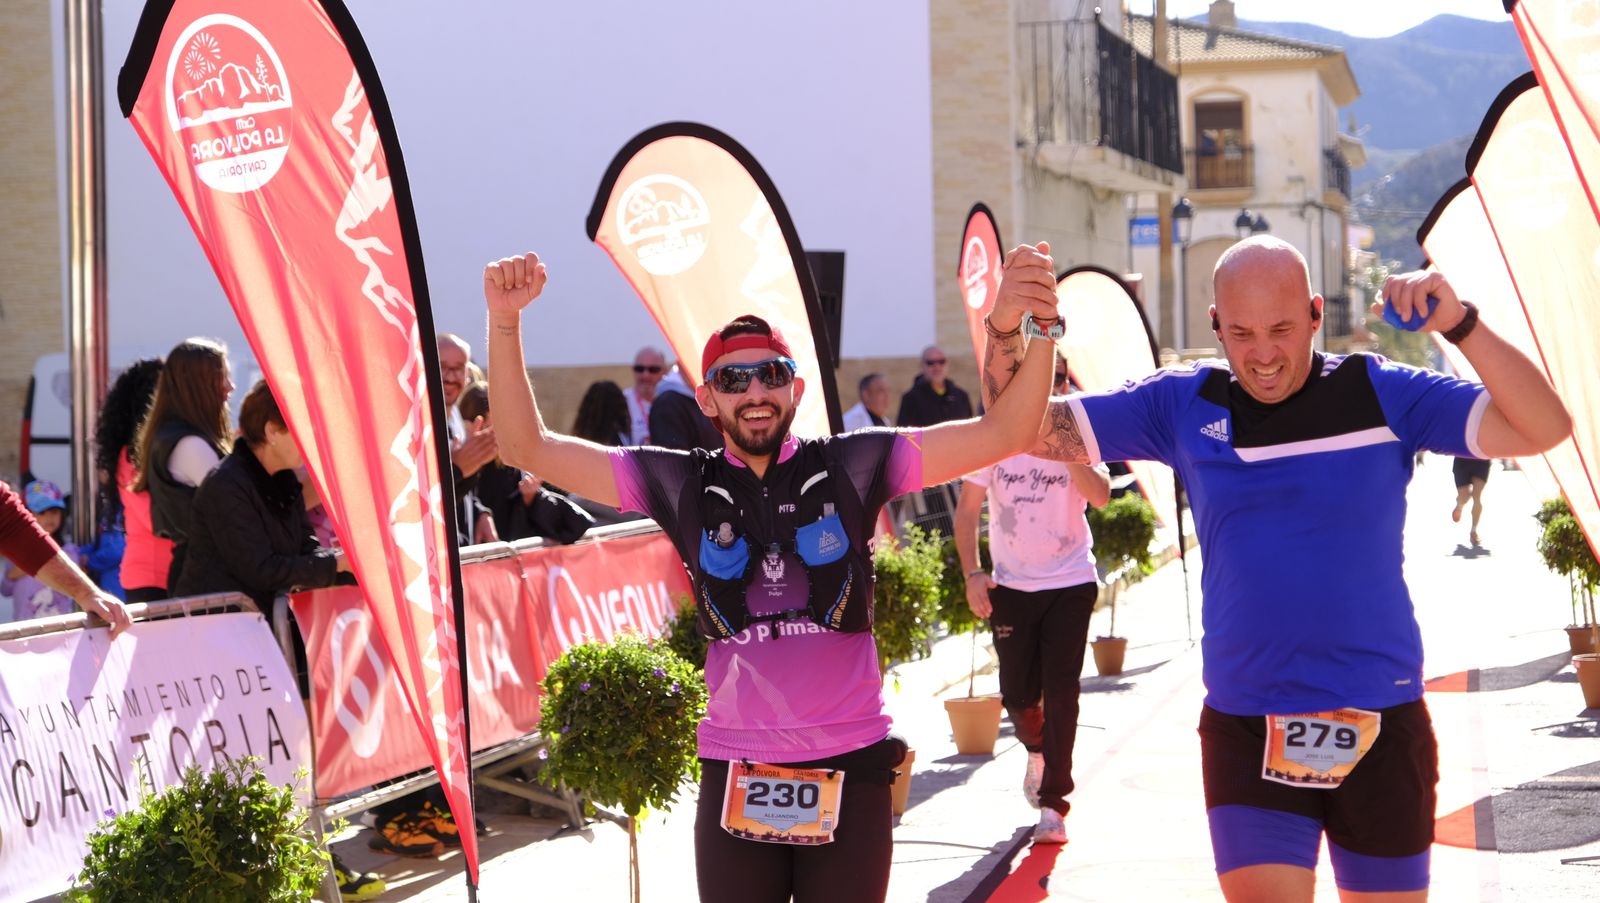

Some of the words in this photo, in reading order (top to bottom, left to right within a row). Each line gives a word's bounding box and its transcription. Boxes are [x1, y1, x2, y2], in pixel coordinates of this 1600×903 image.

[1200, 427, 1229, 442] adidas
[993, 464, 1026, 490] Pepe
[1029, 468, 1068, 492] Yepes
[779, 504, 796, 513] MTB
[0, 674, 225, 741] AYUNTAMIENTO
[236, 665, 272, 696] DE
[1286, 721, 1357, 750] 279
[11, 707, 291, 828] CANTORIA
[746, 781, 819, 809] 230
